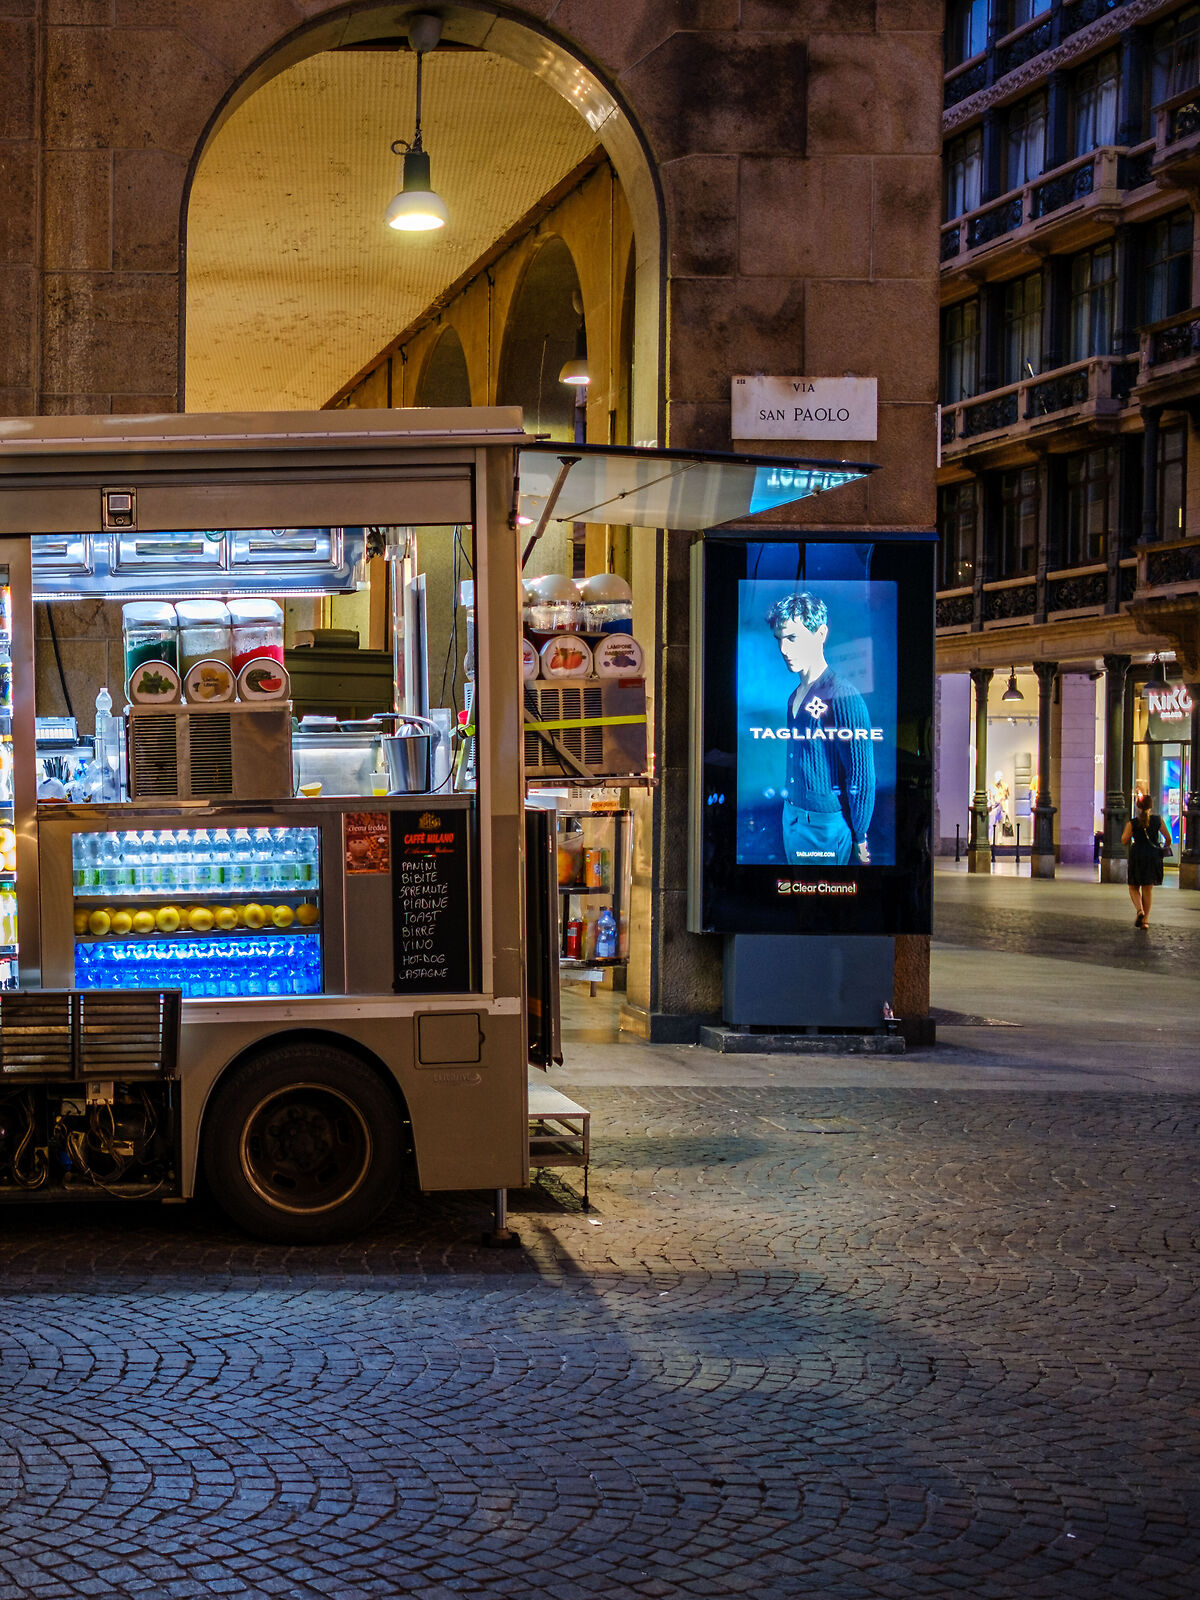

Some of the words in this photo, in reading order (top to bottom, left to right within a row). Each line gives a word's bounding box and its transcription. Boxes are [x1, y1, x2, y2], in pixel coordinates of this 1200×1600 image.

[793, 383, 815, 393] VIA
[759, 409, 785, 421] SAN
[794, 407, 850, 422] PAOLO
[749, 727, 884, 741] TAGLIATORE
[426, 832, 455, 844] MILANO
[791, 882, 817, 893] Clear
[817, 882, 856, 893] Channel
[403, 909, 442, 925] TOAST
[402, 938, 434, 952] VINO
[402, 953, 446, 966] HOT-DOG
[399, 967, 449, 980] CASTAGNE
